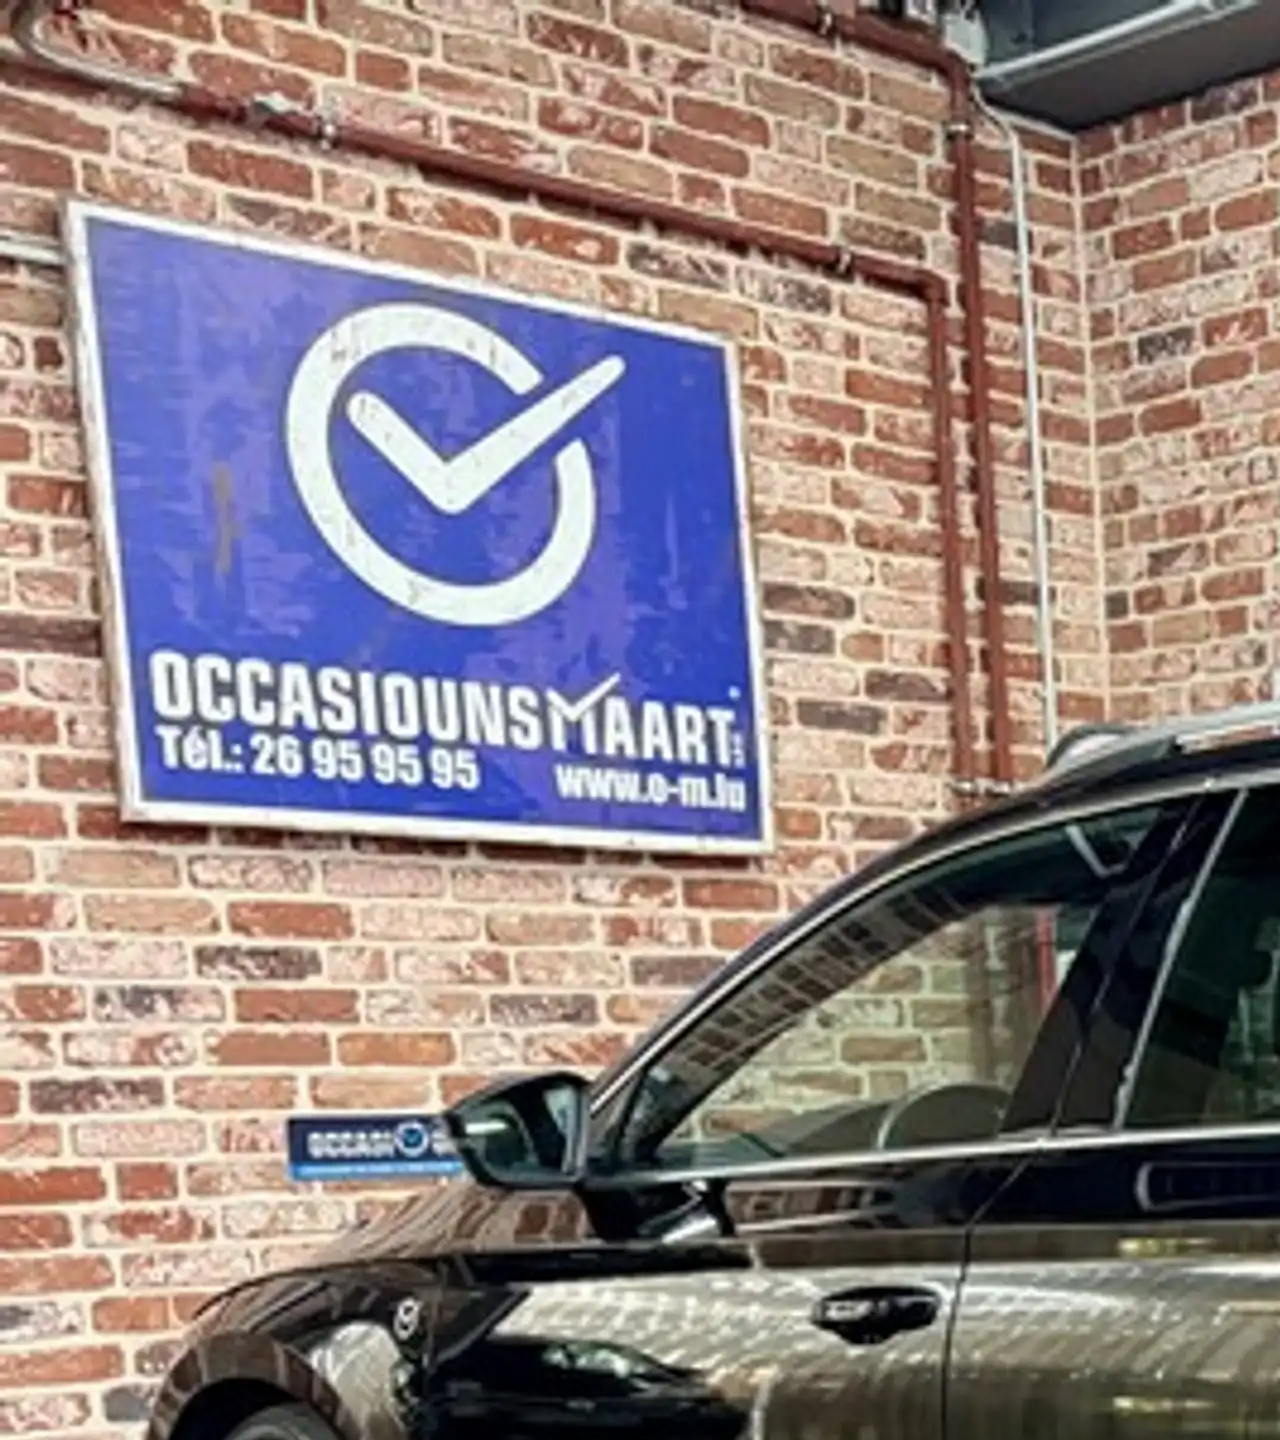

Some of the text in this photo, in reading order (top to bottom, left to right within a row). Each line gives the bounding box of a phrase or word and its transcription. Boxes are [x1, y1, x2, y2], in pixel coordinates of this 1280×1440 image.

[150, 650, 736, 768] OCCASIOUNSMAART
[250, 732, 303, 778] 26
[311, 738, 364, 783] 95
[370, 742, 423, 787] 95
[430, 746, 480, 791] 95
